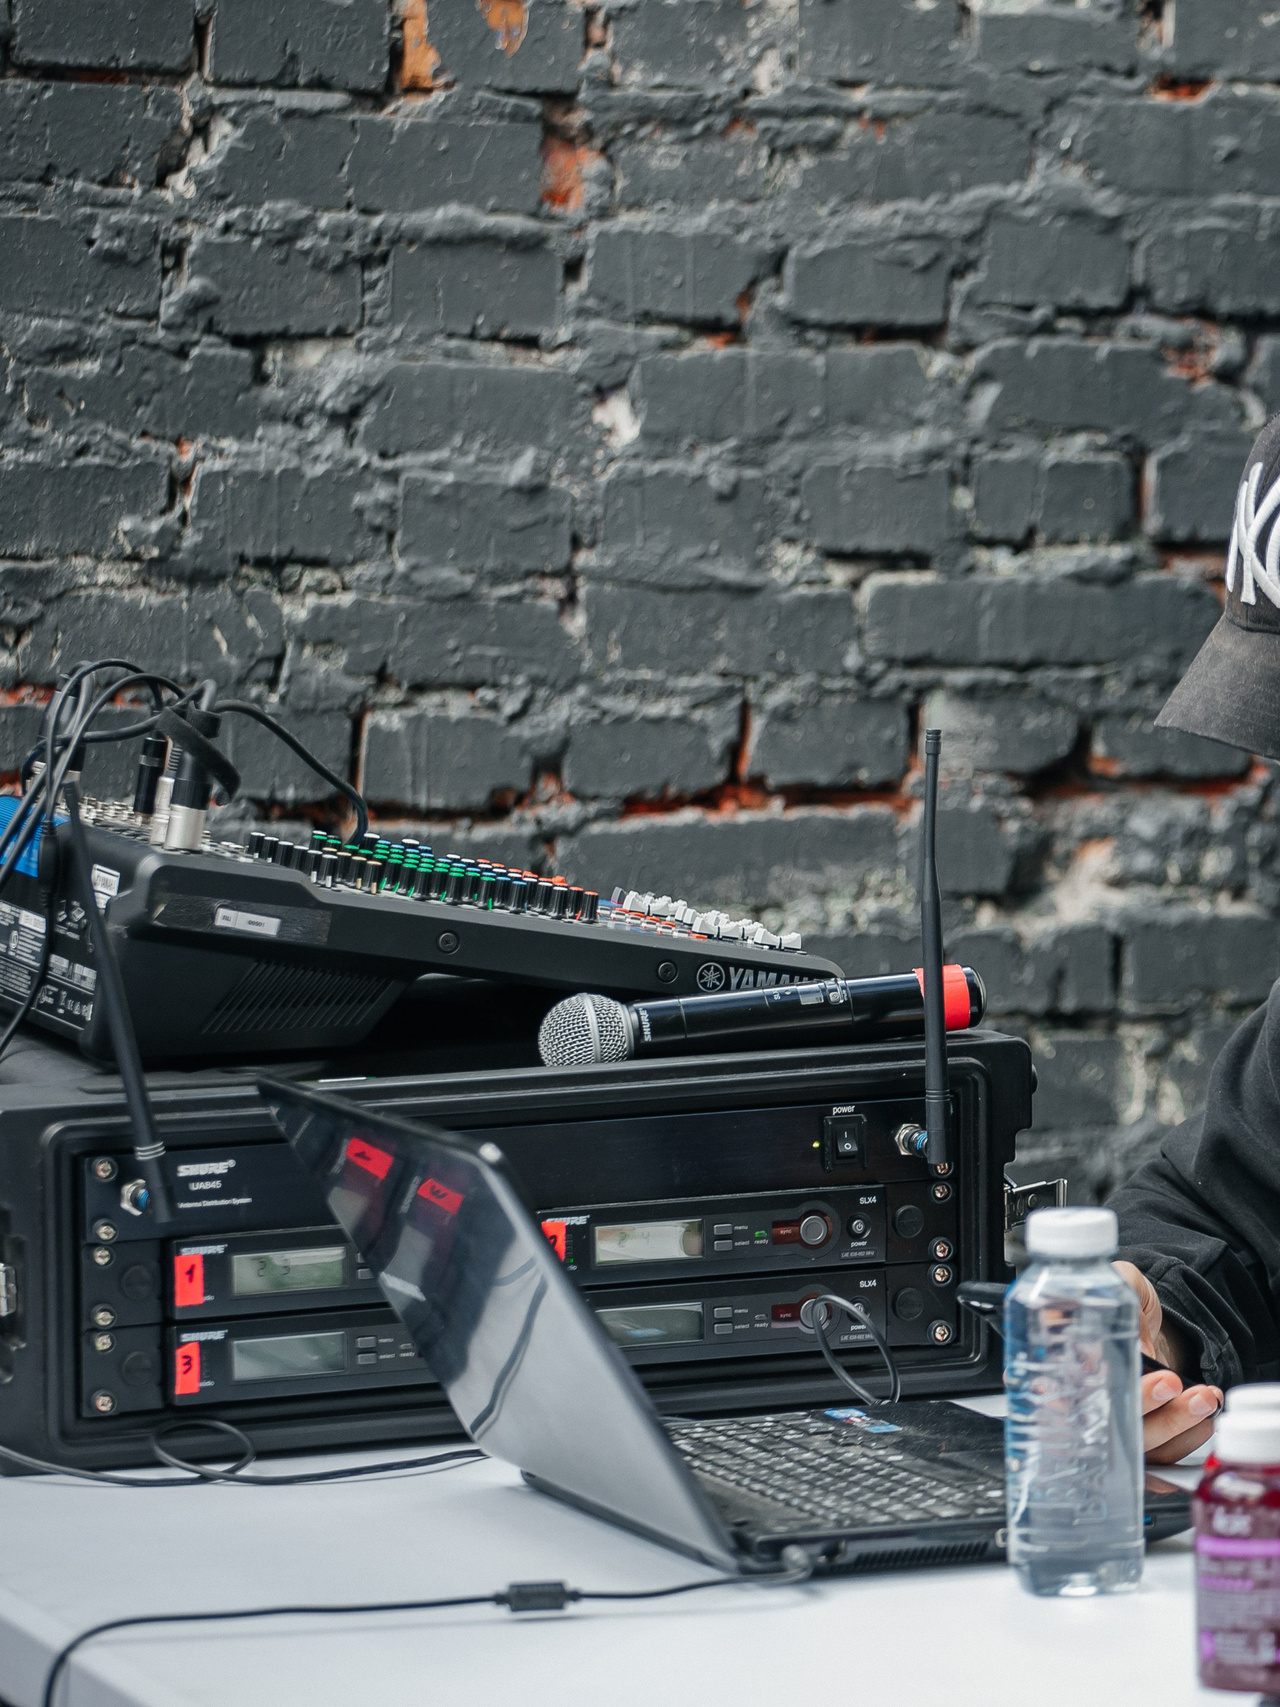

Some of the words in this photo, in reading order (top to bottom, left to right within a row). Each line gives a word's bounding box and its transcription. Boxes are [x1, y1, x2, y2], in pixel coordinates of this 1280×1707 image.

[833, 1105, 855, 1115] power
[860, 1196, 877, 1204] SLX4
[860, 1280, 877, 1288] SLX4
